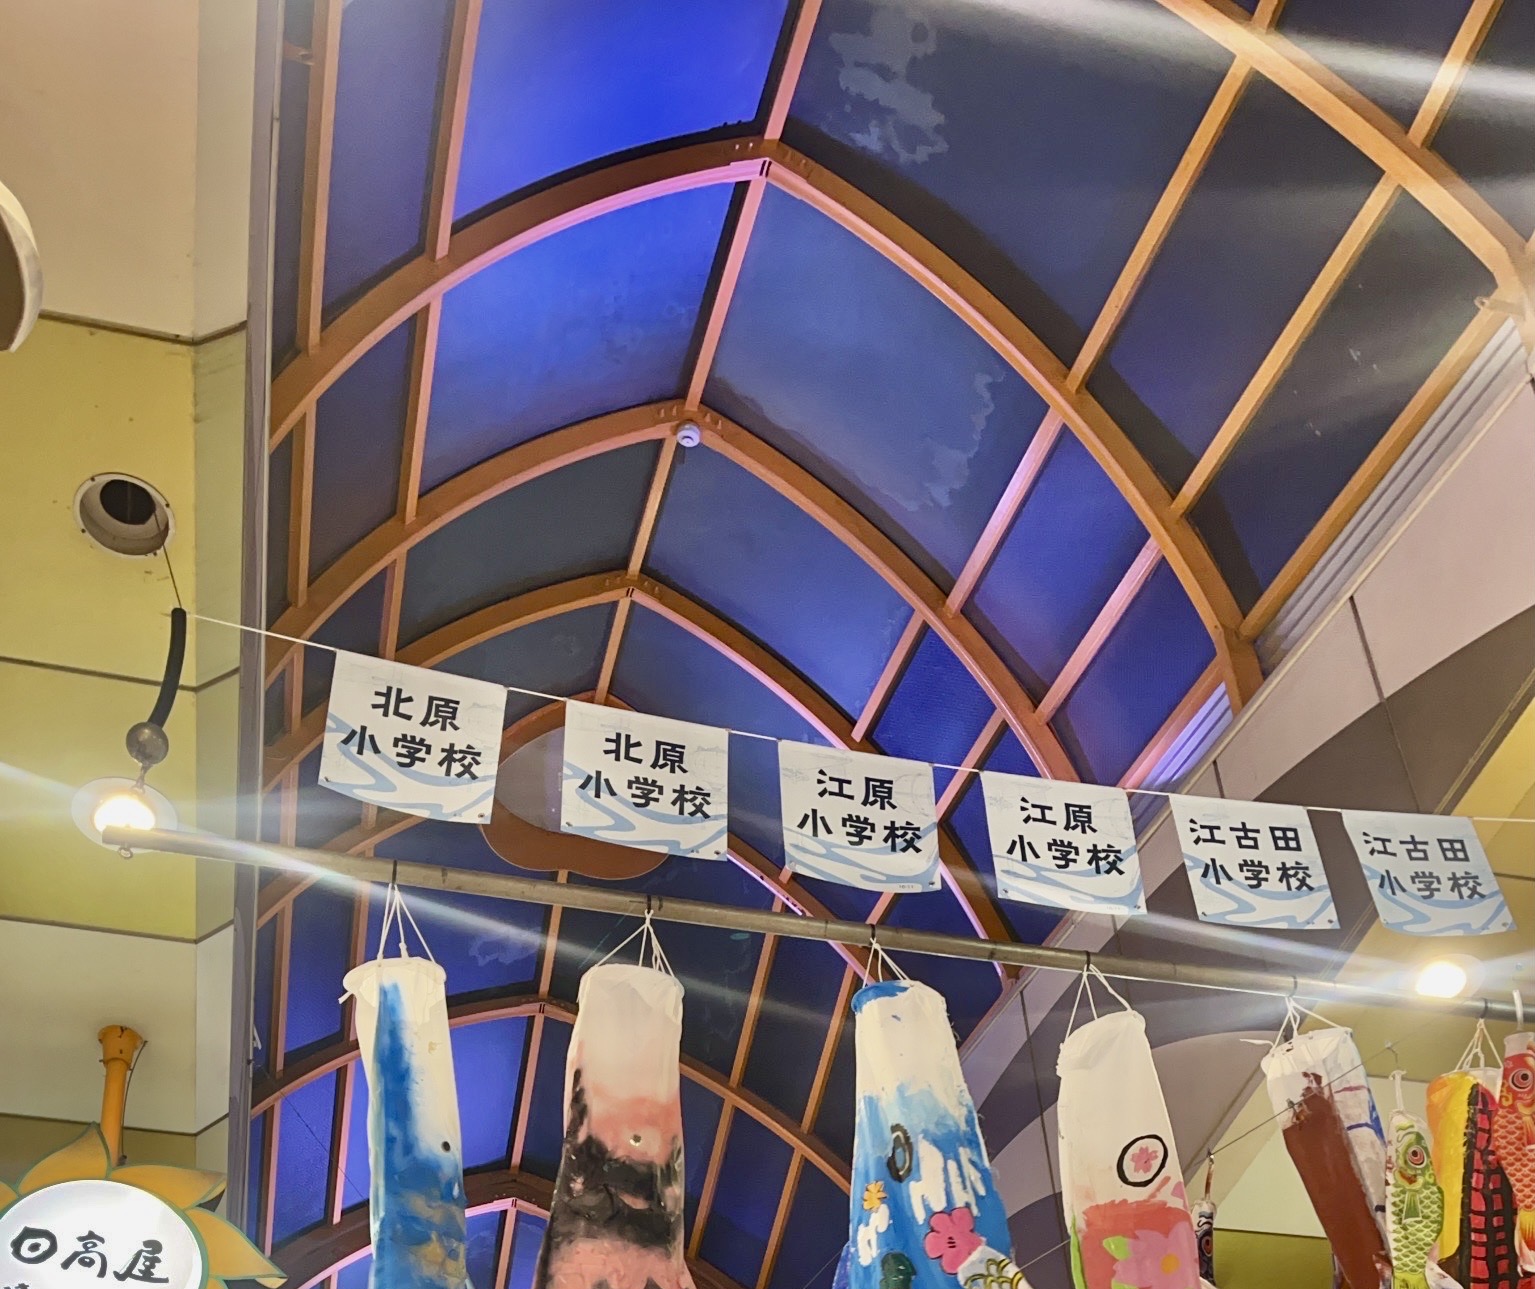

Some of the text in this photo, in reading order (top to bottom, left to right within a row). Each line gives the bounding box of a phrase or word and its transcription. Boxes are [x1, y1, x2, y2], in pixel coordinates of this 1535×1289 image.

[371, 685, 462, 732] 北原
[341, 724, 483, 780] 小学校
[603, 732, 688, 775] 北原
[578, 769, 713, 820] 小学校
[817, 768, 898, 811] 江原
[797, 808, 925, 855] 小学校
[1019, 796, 1098, 836] 江原
[1189, 818, 1301, 852] 江古田
[1006, 834, 1126, 876] 小学校
[1361, 831, 1468, 864] 江古田
[1200, 857, 1315, 892] 小学校
[1377, 869, 1488, 901] 小学校
[10, 1226, 170, 1284] 日高屋
